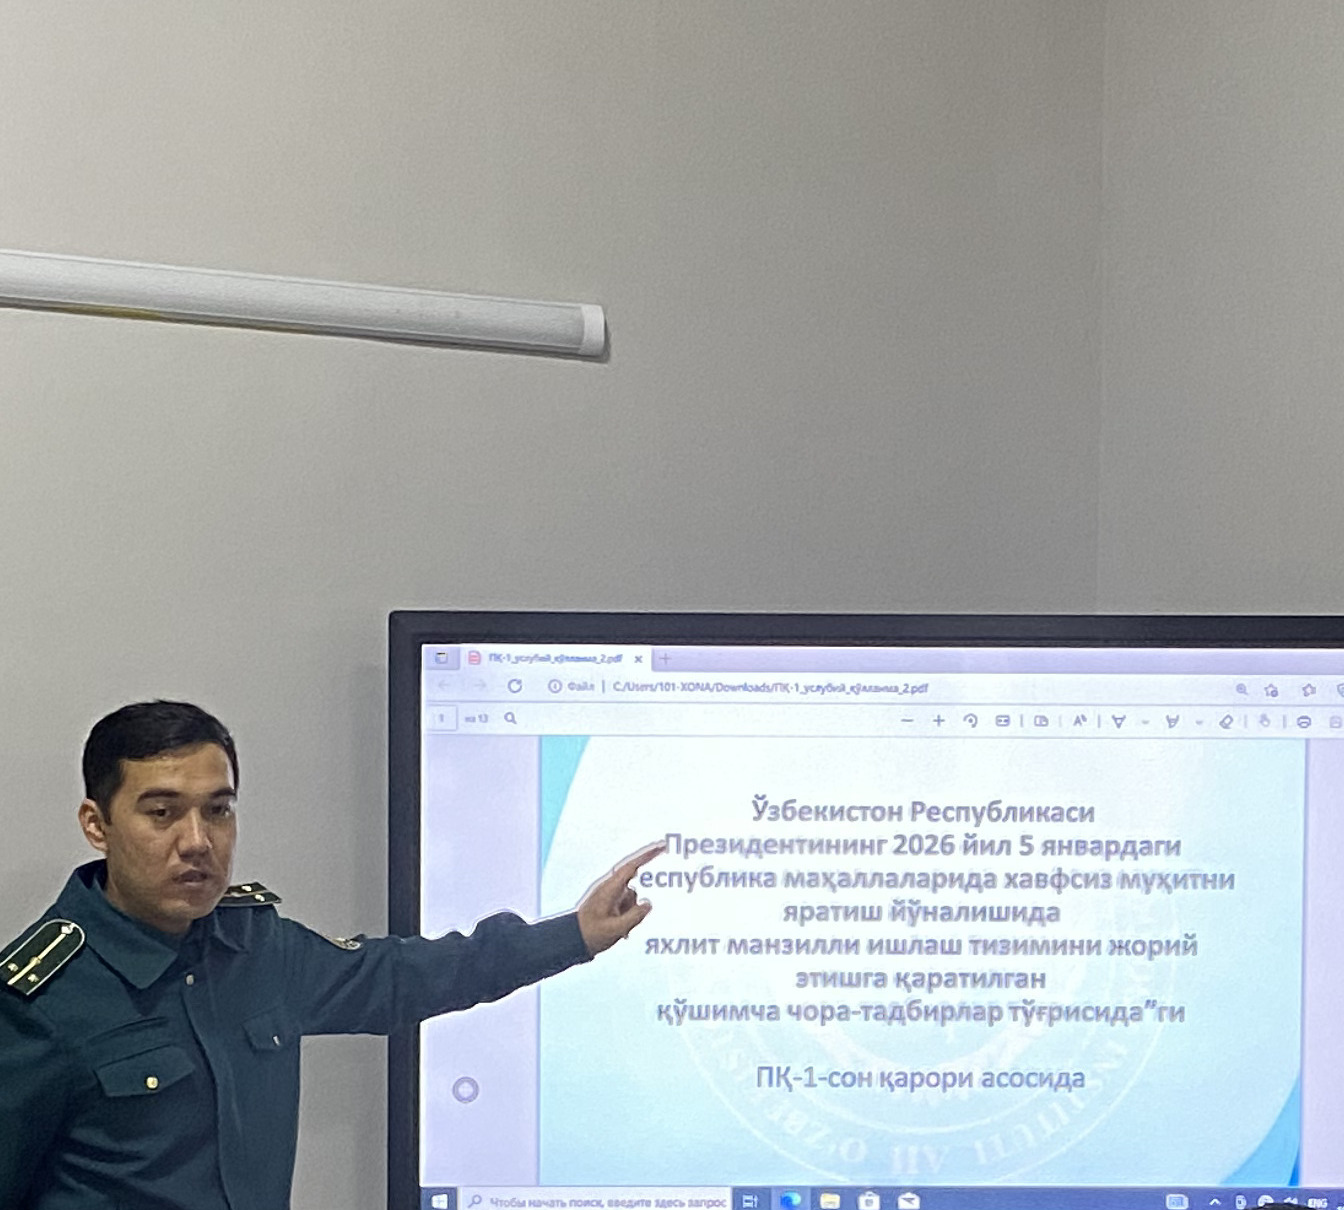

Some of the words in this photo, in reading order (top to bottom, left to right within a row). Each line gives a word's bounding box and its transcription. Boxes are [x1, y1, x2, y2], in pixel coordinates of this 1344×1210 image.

[752, 794, 904, 823] Ўзбекистон
[911, 799, 1095, 828] Республикаси
[664, 833, 888, 860] Президентининг
[892, 833, 956, 857] 2026
[962, 832, 1012, 857] йил
[1018, 834, 1035, 857] 5
[1041, 839, 1182, 862] январдаги
[639, 865, 777, 894] еспублика
[783, 870, 998, 895] маҳаллаларида
[1004, 866, 1113, 895] хавфсиз
[1117, 871, 1236, 896] муҳитни
[783, 904, 883, 927] яратиш
[888, 899, 1062, 928] йўналишида
[645, 937, 721, 956] яхлит
[727, 938, 861, 956] манзилли
[866, 938, 963, 956] ишлаш
[969, 938, 1102, 957] тизимини
[1108, 933, 1198, 961] жорий
[795, 970, 888, 989] этишга
[894, 971, 1047, 994] қаратилган
[657, 997, 781, 1026] қўшимча
[787, 999, 1004, 1027] чора-тадбирлар
[756, 1065, 873, 1093] ПҚ-1-сон
[880, 1070, 974, 1094] қарори
[981, 1071, 1086, 1094] асосида
[490, 1197, 526, 1208] Чтобы
[528, 1199, 568, 1208] начать
[569, 1199, 605, 1209] поиск,
[607, 1199, 652, 1209] введите
[654, 1199, 686, 1210] здесь
[688, 1199, 727, 1210] запрос
[1307, 1198, 1328, 1209] ENG
